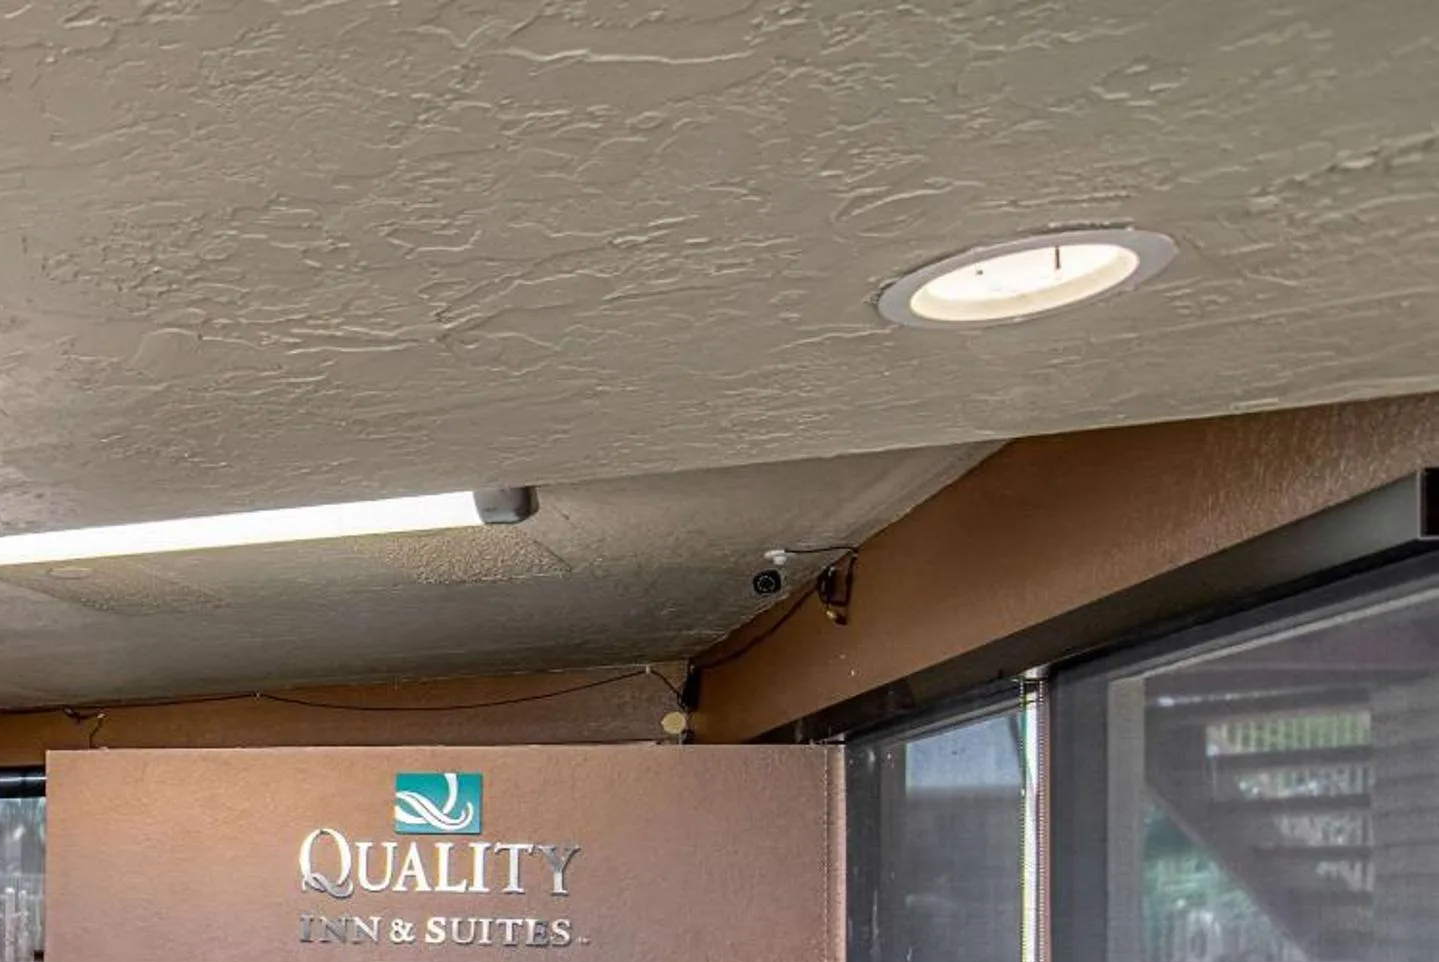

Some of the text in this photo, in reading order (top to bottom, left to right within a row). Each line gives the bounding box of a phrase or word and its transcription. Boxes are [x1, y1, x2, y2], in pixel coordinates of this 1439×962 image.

[299, 827, 581, 899] QUALITY
[299, 915, 573, 948] INN & SUITES
